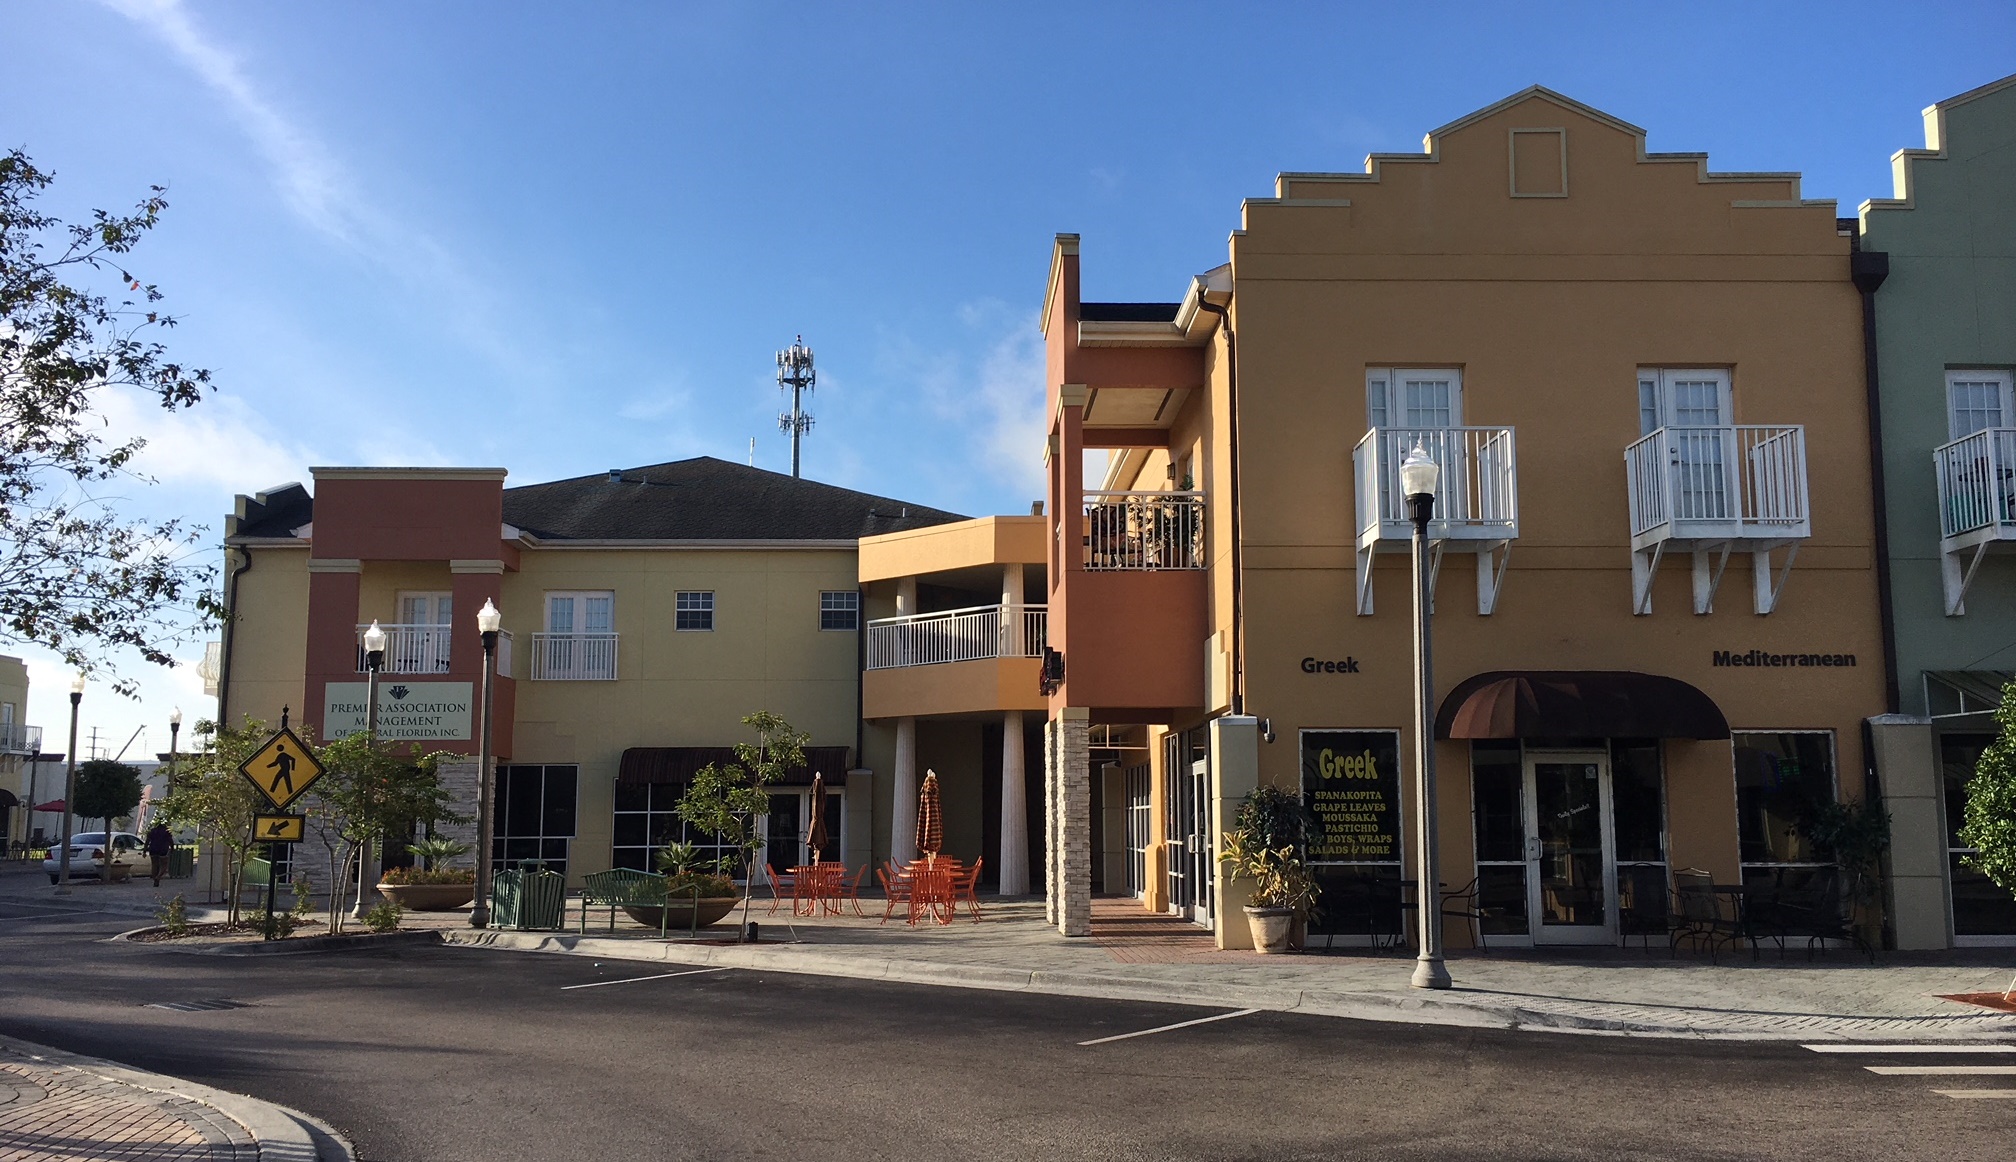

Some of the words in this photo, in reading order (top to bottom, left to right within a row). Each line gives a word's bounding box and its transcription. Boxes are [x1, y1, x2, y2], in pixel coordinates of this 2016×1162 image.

[1713, 650, 1856, 666] Mediterranean
[1301, 656, 1359, 673] Greek
[331, 703, 383, 713] PREMIR
[385, 703, 466, 713] ASSOCIATION
[354, 716, 442, 726] MNAGEMENT
[335, 729, 348, 737] OF
[396, 729, 438, 737] FLORIDA
[440, 729, 460, 737] INC.
[1319, 748, 1378, 779] Greek
[1315, 791, 1382, 800] SPANAKOPITA
[1313, 803, 1347, 812] GRAPE
[1349, 803, 1386, 812] LEAVES
[1322, 813, 1378, 822] MOUSSAKA
[1325, 824, 1379, 833] PASTICHIO
[1358, 834, 1392, 843] WRAPS
[1308, 845, 1348, 854] SALADS
[1351, 845, 1359, 854] &
[1361, 845, 1390, 854] MORE
